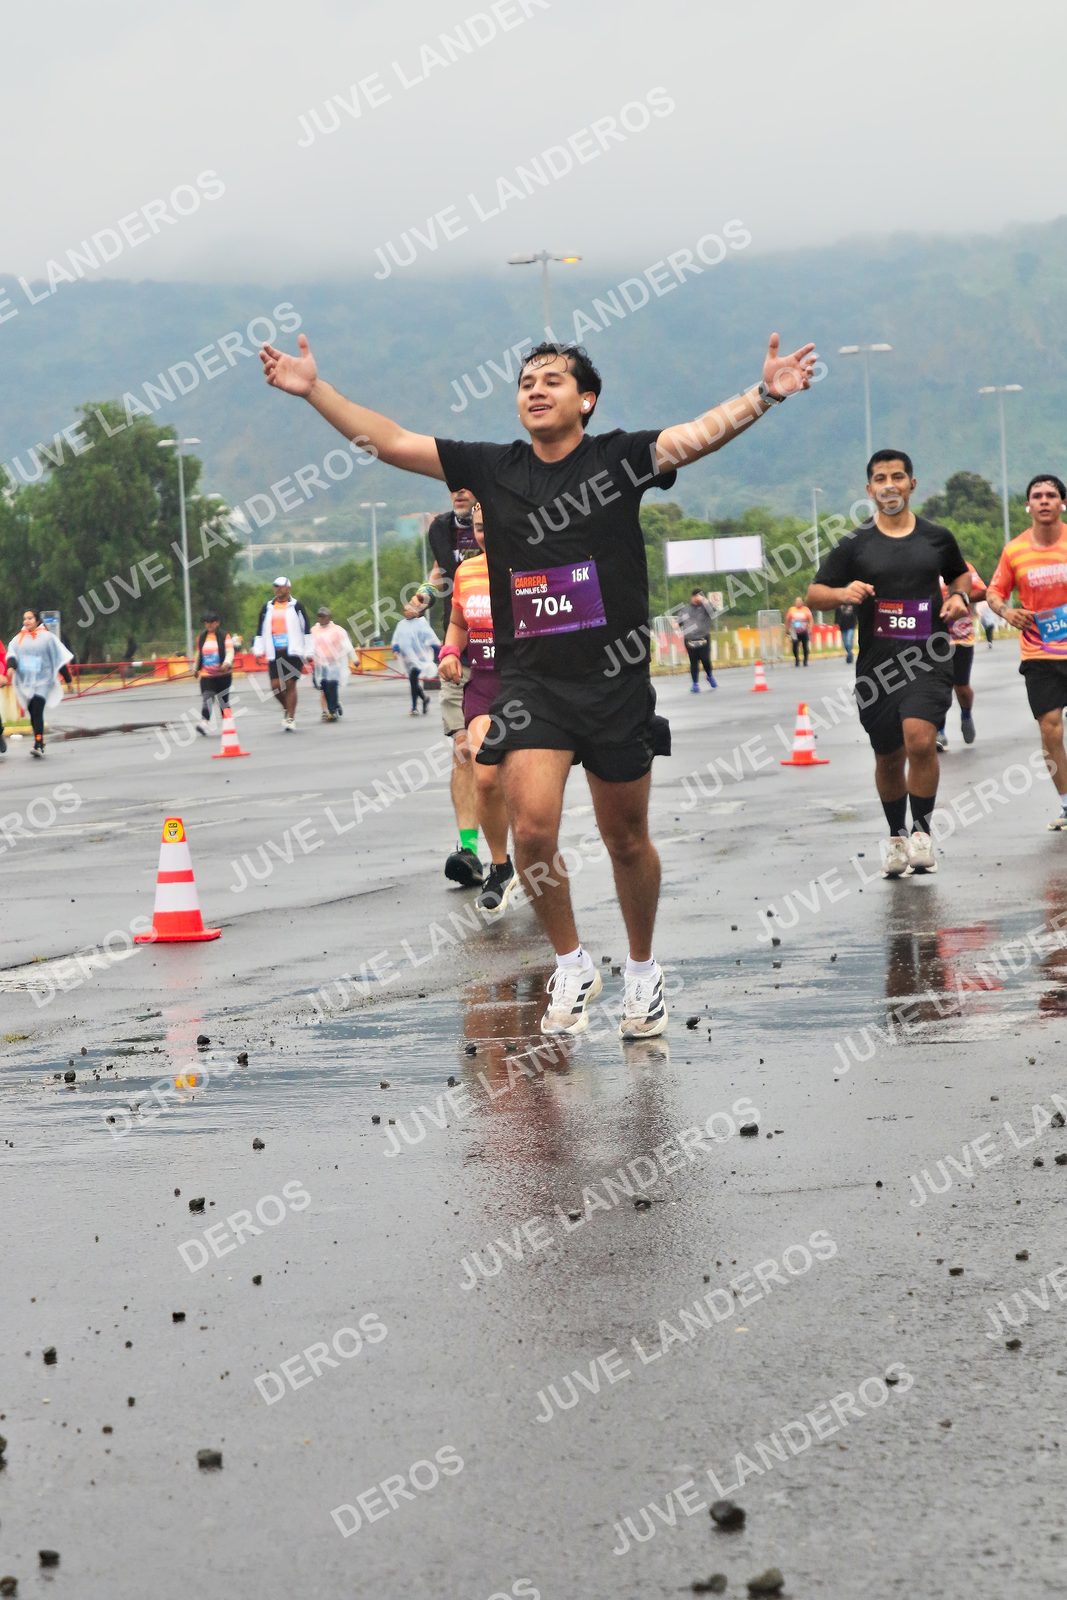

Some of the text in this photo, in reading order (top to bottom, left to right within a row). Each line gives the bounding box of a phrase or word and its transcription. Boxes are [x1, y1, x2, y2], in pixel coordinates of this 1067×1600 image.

[515, 575, 547, 588] CARRERA
[532, 595, 573, 617] 704
[889, 616, 916, 629] 368
